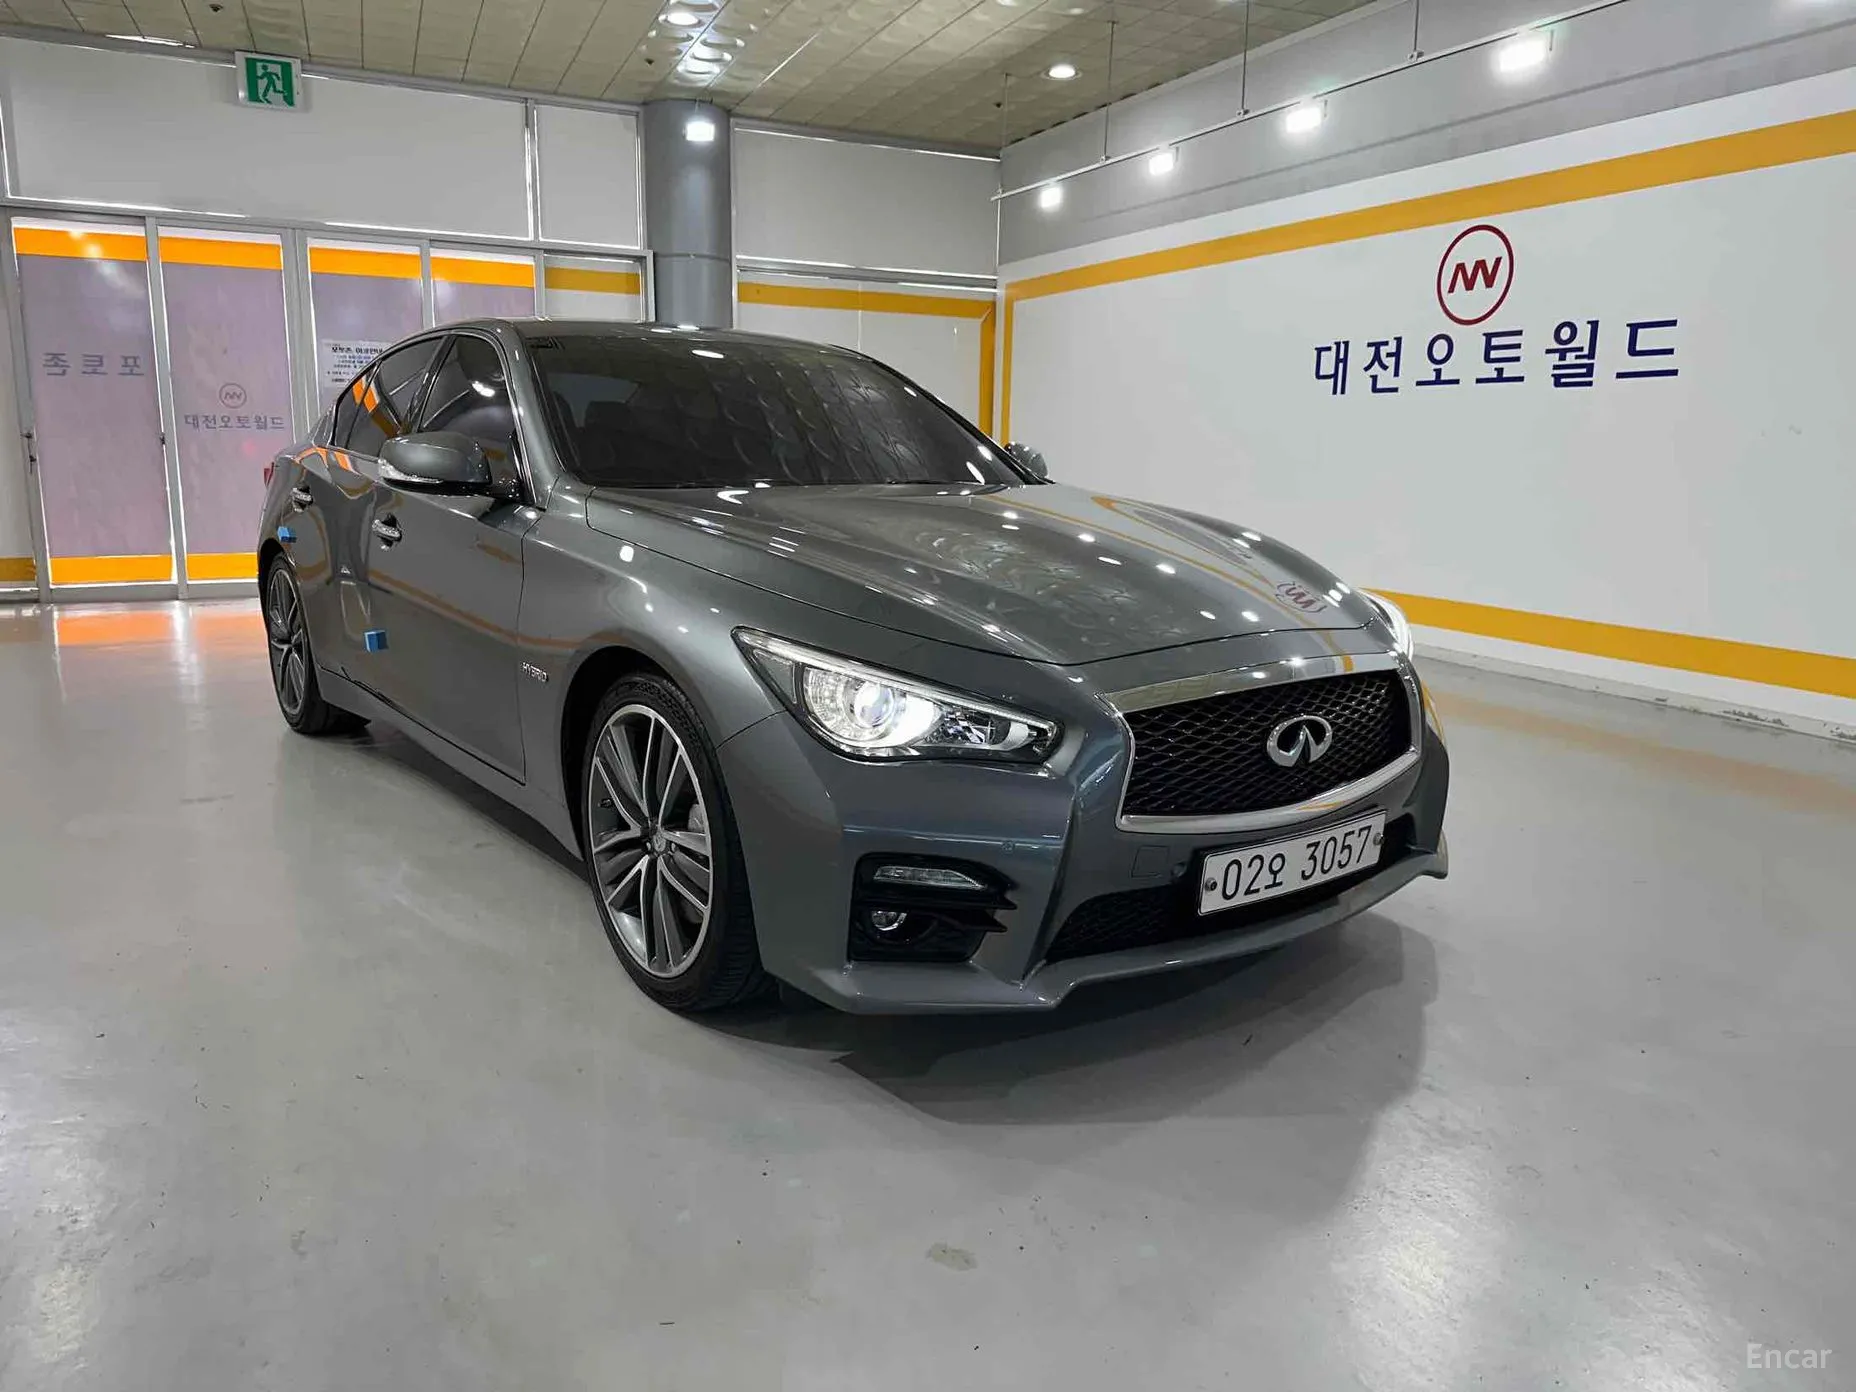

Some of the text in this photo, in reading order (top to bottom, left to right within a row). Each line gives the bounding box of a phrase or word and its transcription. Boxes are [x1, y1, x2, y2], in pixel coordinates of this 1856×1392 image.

[1314, 319, 1679, 395] 대전오토월드
[184, 414, 285, 430] 대전오토월드
[1222, 825, 1372, 900] 02오 3057
